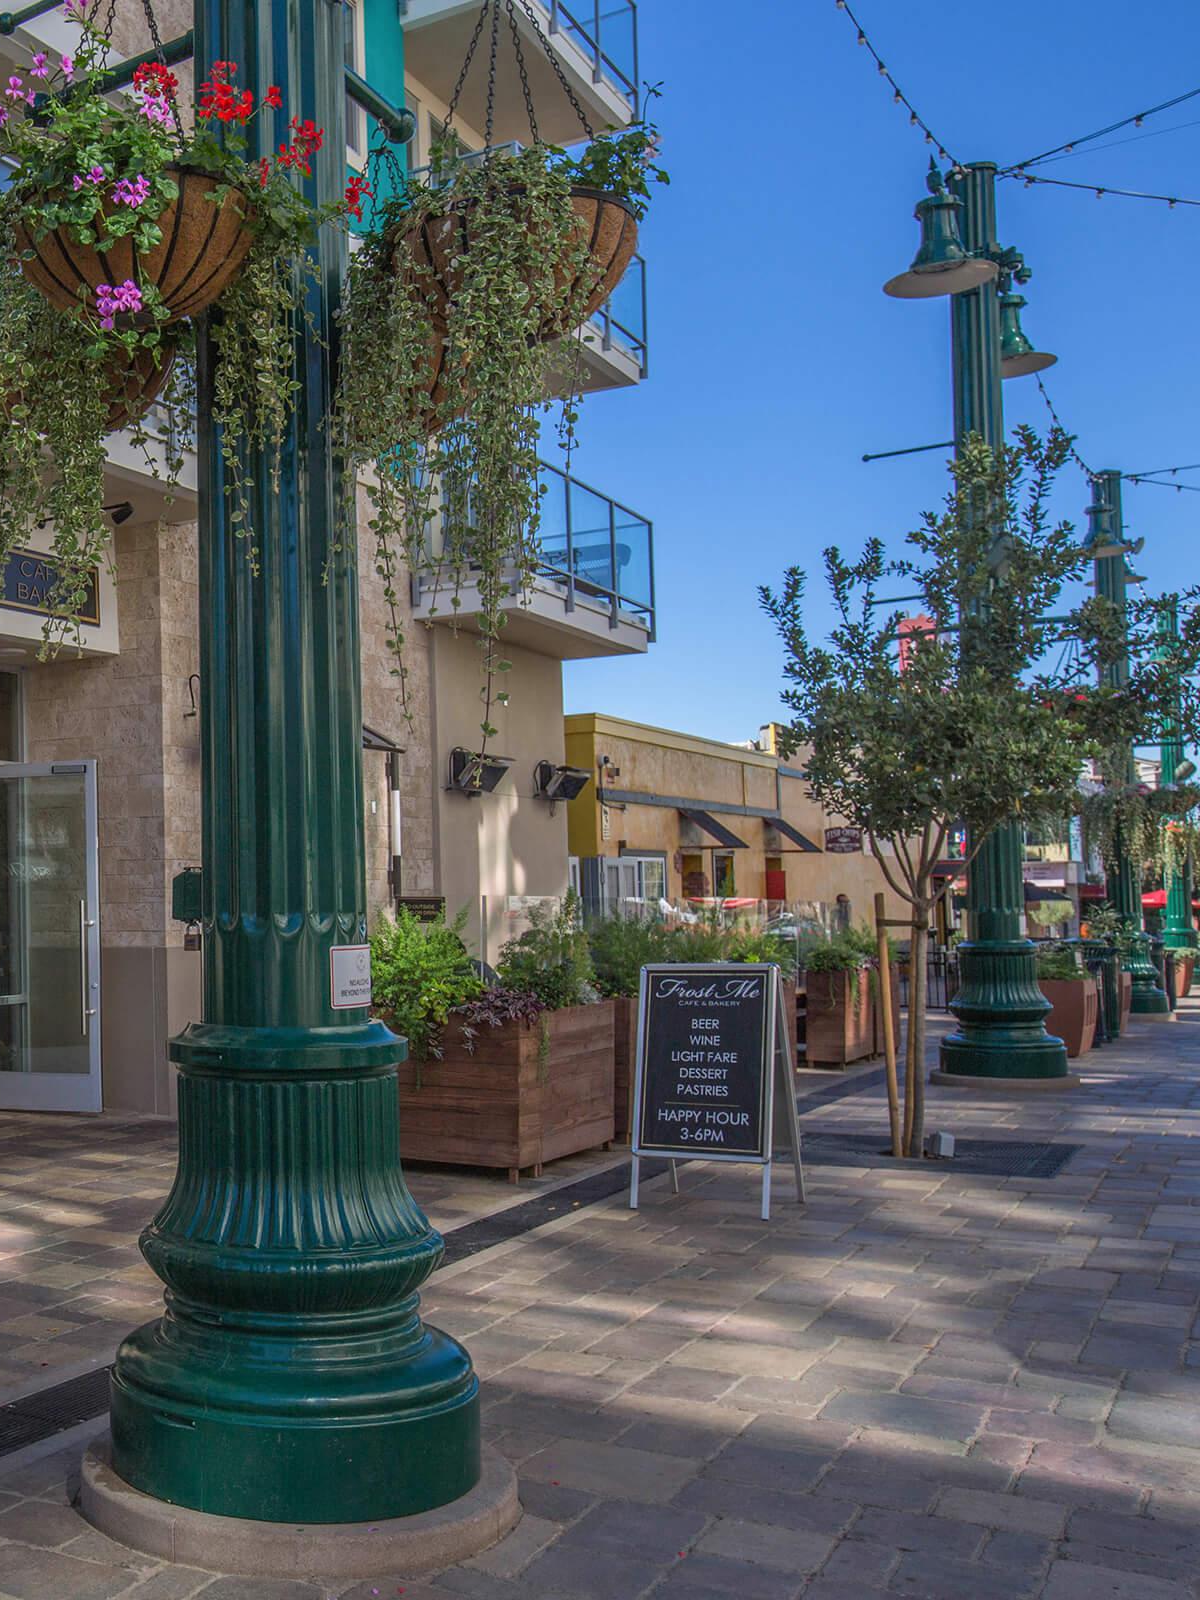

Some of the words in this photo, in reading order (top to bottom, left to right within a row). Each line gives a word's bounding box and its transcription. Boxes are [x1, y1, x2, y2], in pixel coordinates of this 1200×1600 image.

[19, 560, 54, 582] CAF
[17, 582, 54, 601] BAK
[655, 978, 717, 999] Frost
[714, 978, 761, 999] Me
[691, 1018, 720, 1030] BEER
[689, 1034, 721, 1047] WINE
[671, 1050, 705, 1062] LIGHT
[707, 1051, 738, 1064] FARE
[679, 1067, 728, 1080] DESSERT
[676, 1083, 729, 1097] PASTRIES
[657, 1108, 702, 1124] HAPPY
[705, 1111, 750, 1126] HOUR
[679, 1127, 724, 1142] 3-6PM
